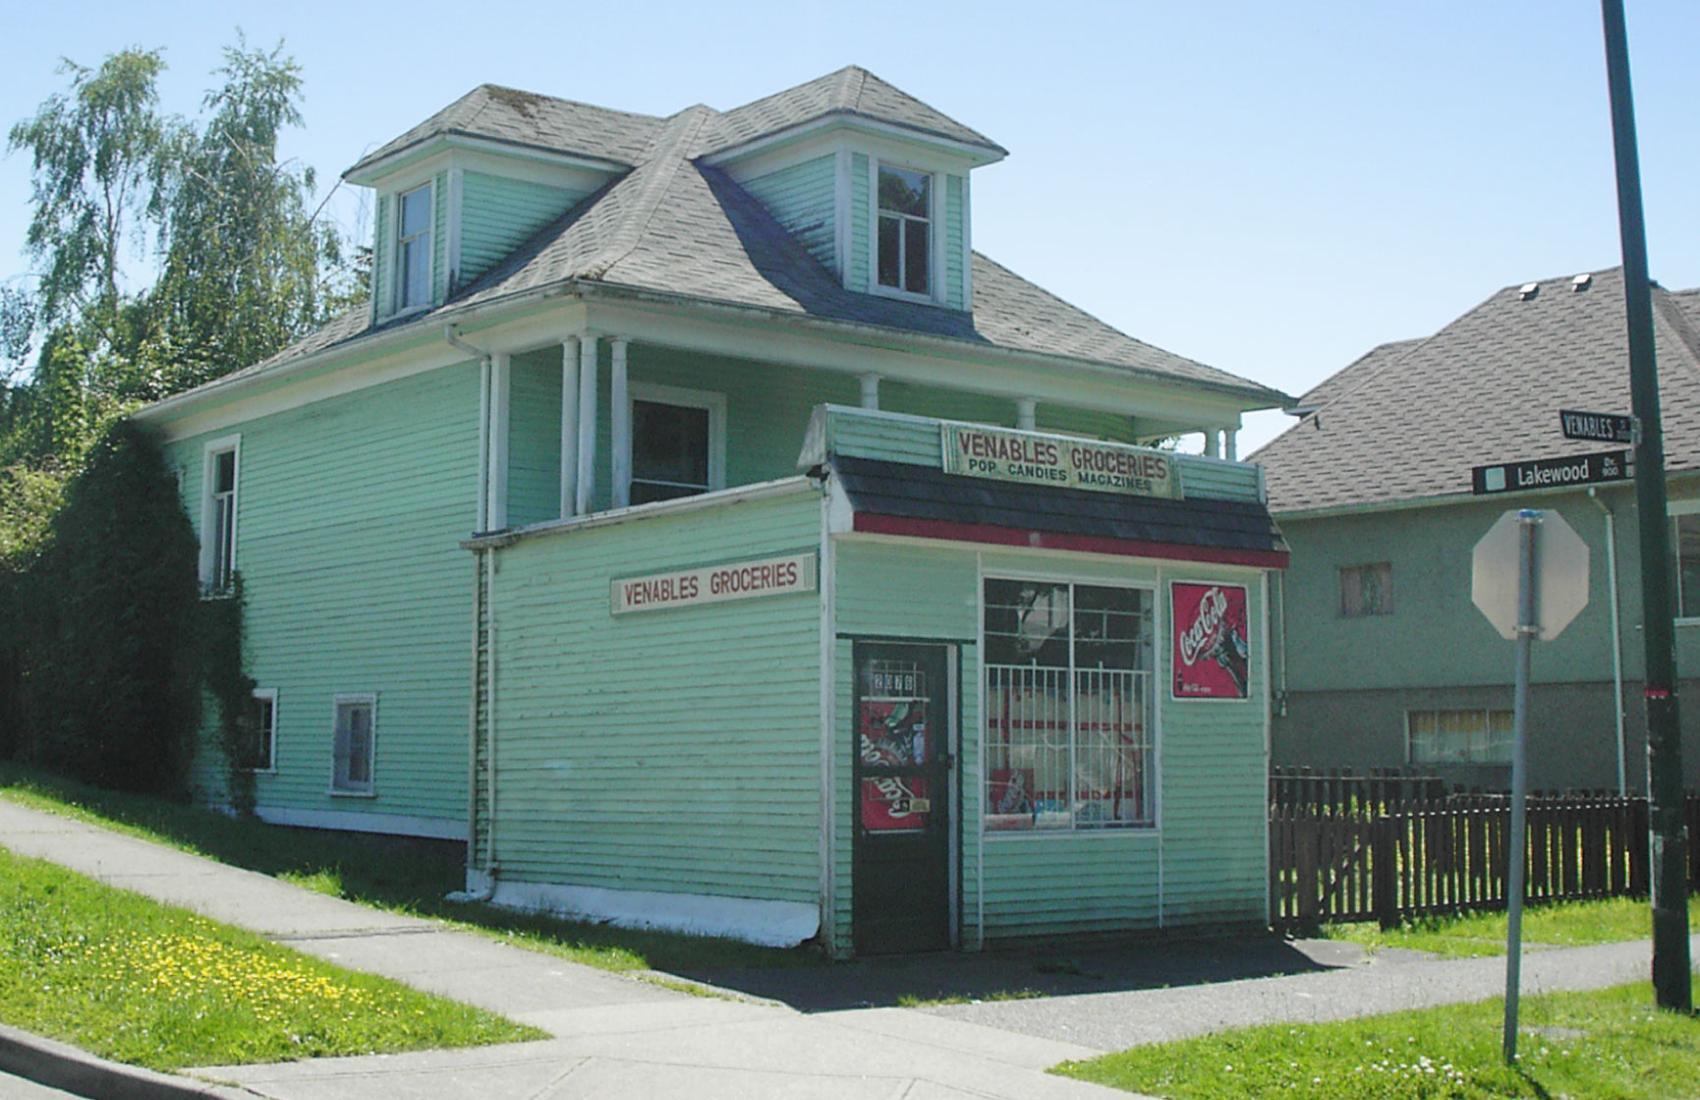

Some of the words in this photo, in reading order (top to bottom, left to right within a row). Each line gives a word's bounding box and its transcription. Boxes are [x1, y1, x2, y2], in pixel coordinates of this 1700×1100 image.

[1563, 415, 1614, 439] VENABLES
[959, 432, 1059, 466] VENABLES
[1071, 448, 1168, 479] GROCERIES
[968, 458, 997, 473] POP
[1008, 465, 1068, 481] CANDIES
[1078, 472, 1152, 491] MAGAZINES
[1518, 459, 1590, 486] Lakewood
[625, 576, 699, 606] VENABLES
[710, 562, 797, 594] GROCERIES
